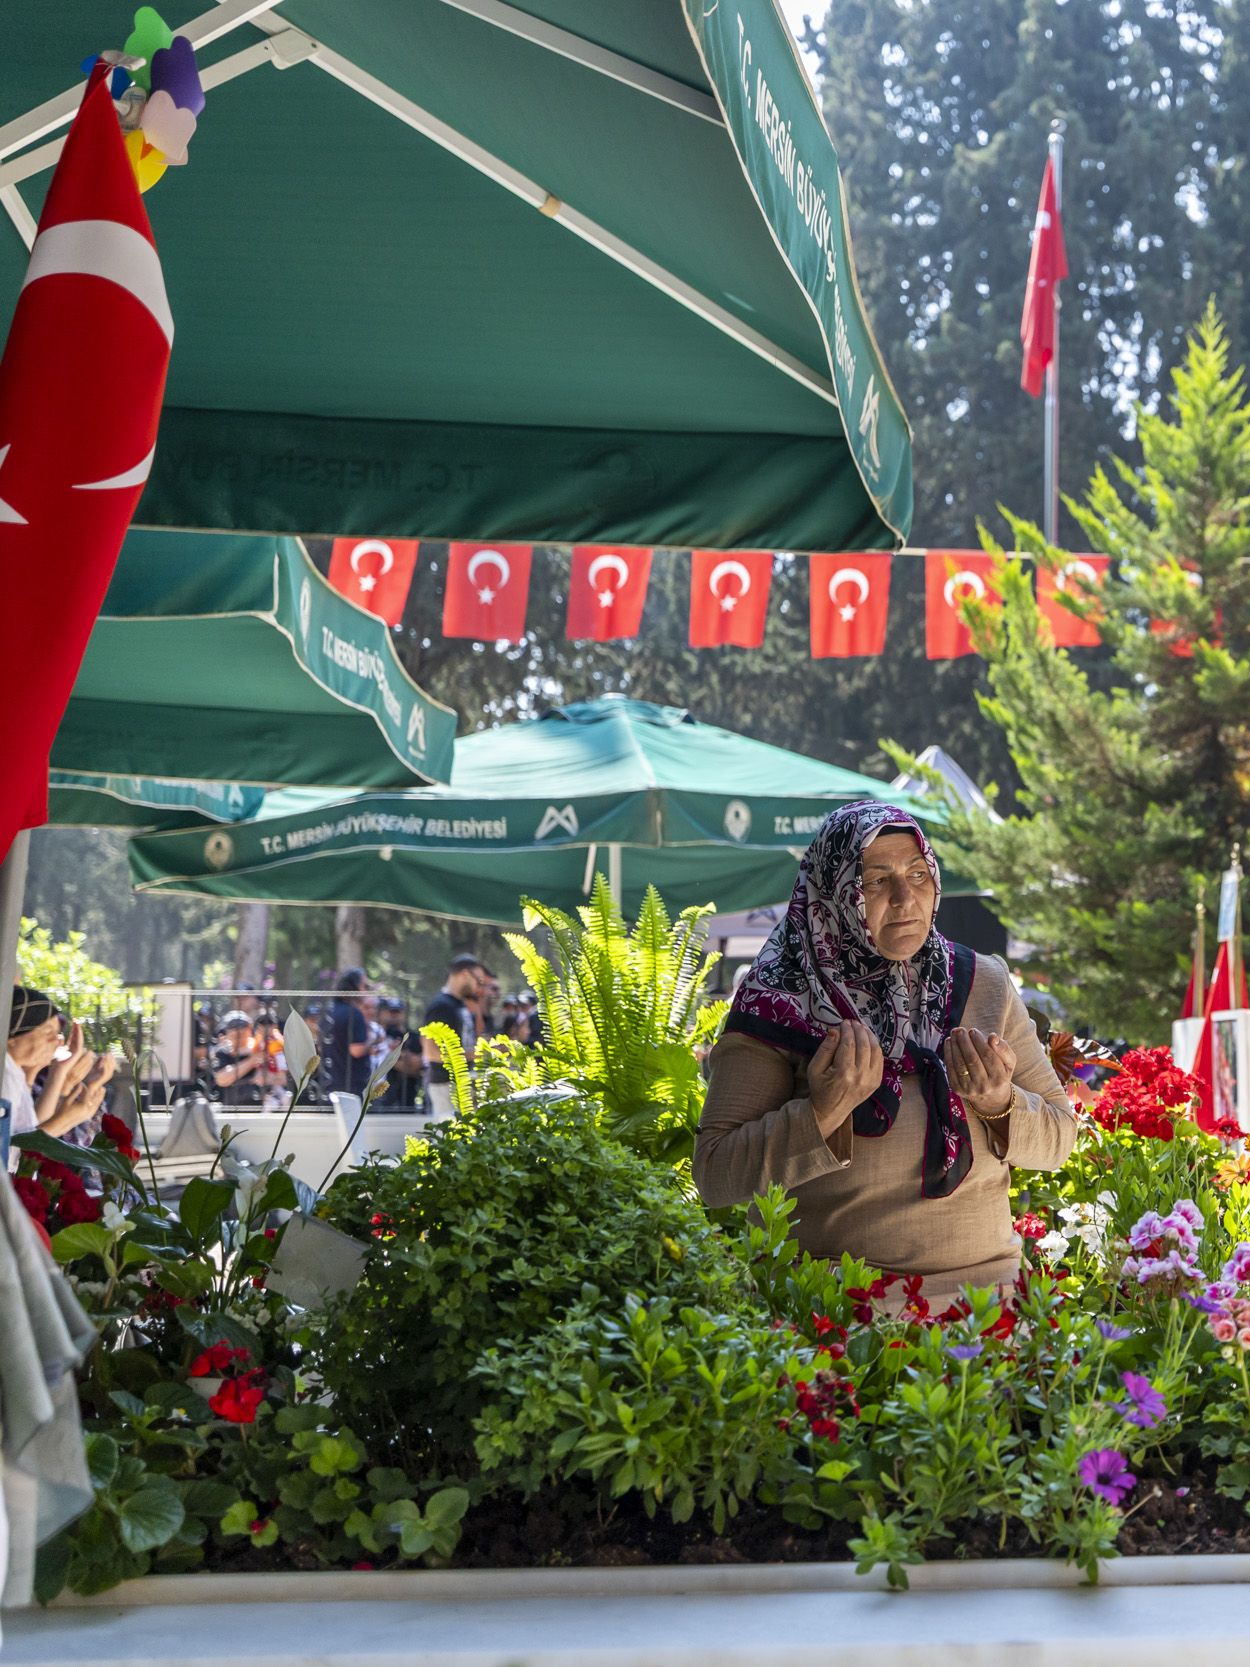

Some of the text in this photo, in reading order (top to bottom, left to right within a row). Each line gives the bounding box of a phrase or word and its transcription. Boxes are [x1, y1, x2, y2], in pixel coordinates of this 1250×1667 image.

[755, 68, 796, 196] MERSİN
[260, 835, 286, 856] T.C.
[286, 821, 335, 851] MERSİN
[424, 816, 507, 840] BELEDİYESİ
